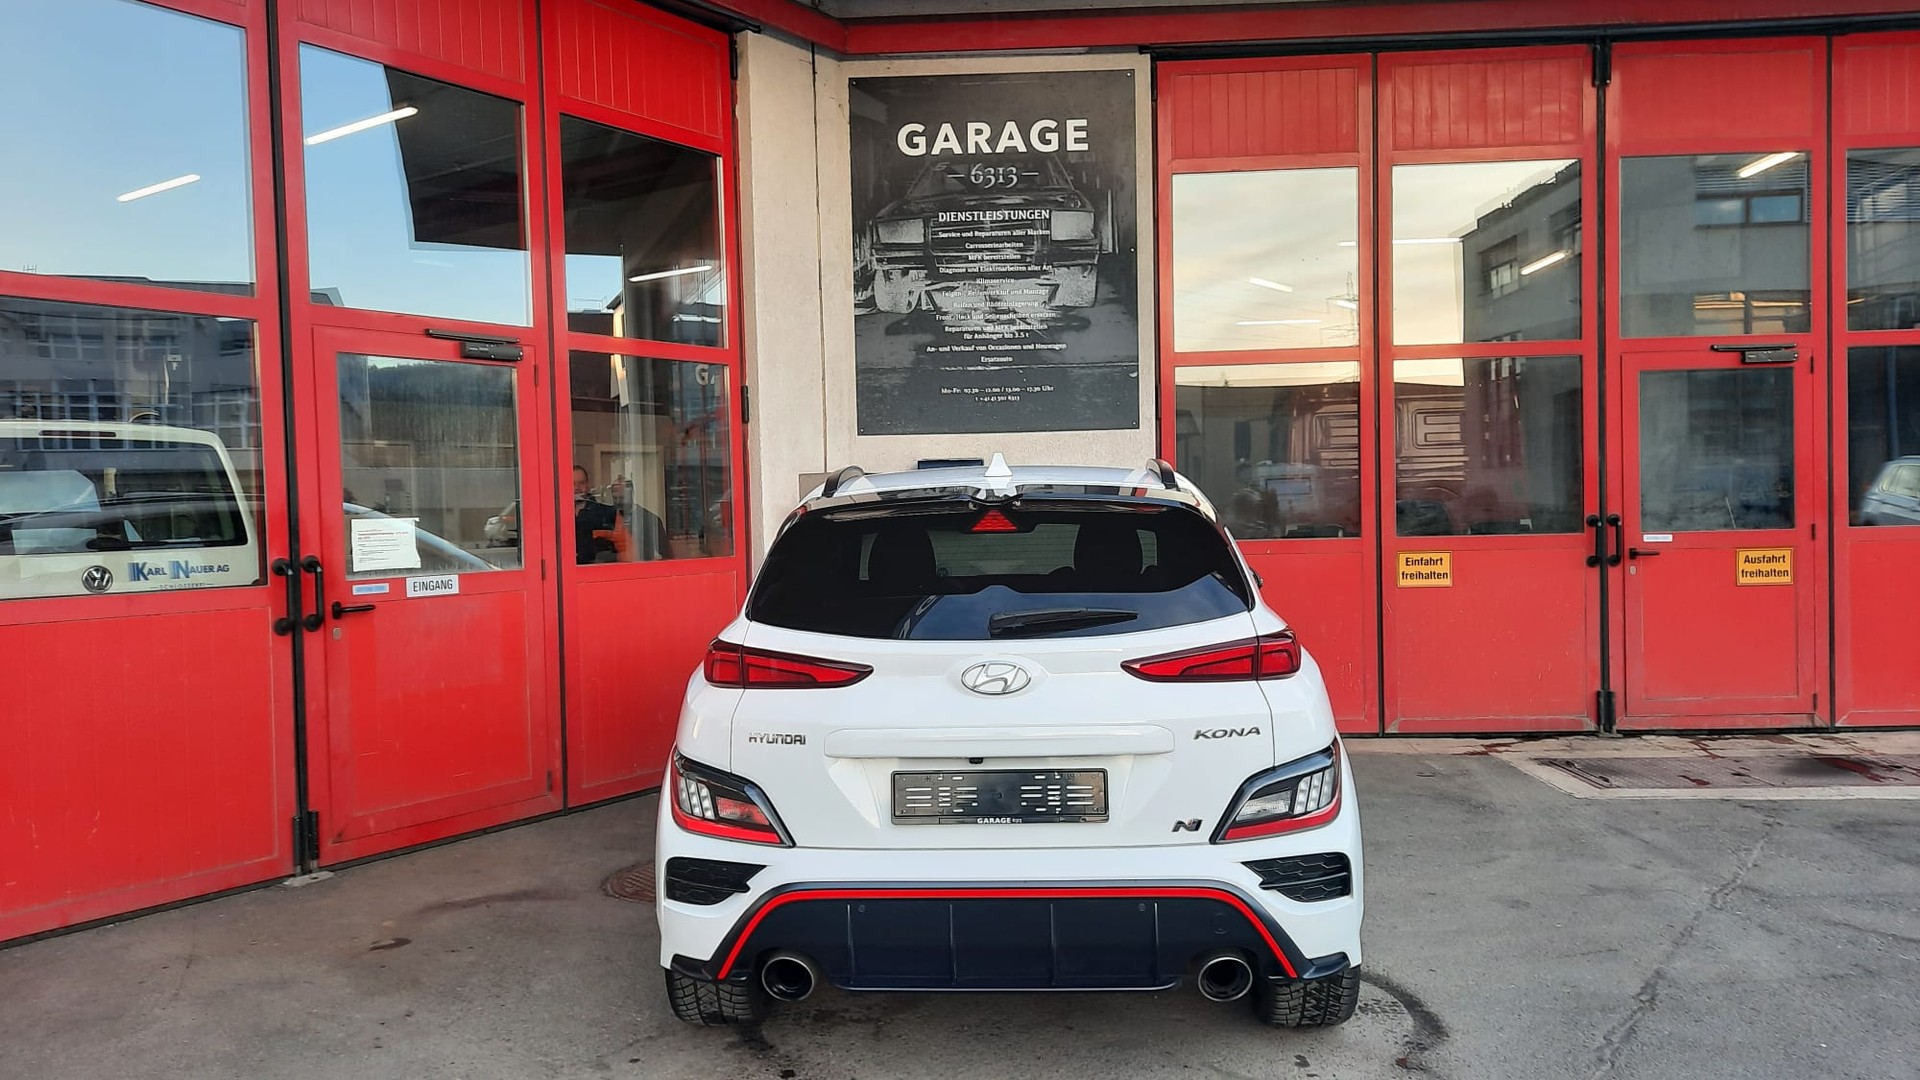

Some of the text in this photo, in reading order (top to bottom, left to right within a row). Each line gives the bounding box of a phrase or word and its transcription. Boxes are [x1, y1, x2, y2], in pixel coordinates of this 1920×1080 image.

[897, 119, 1089, 156] GARAGE
[970, 163, 1018, 189] 6313
[938, 209, 1050, 222] DIENSTLEISTUNGEN
[974, 230, 1011, 238] Reparaturen
[944, 325, 981, 333] Reparaturen
[974, 332, 1003, 340] Anhänger
[1405, 556, 1443, 567] Einfahrt
[1743, 554, 1786, 564] Ausfahrt
[216, 564, 230, 573] AG
[1741, 568, 1789, 578] freihalten
[1401, 570, 1449, 580] freihalten
[412, 579, 453, 592] EINGANG
[1193, 726, 1261, 740] KONA
[748, 732, 806, 745] HYUNDAI
